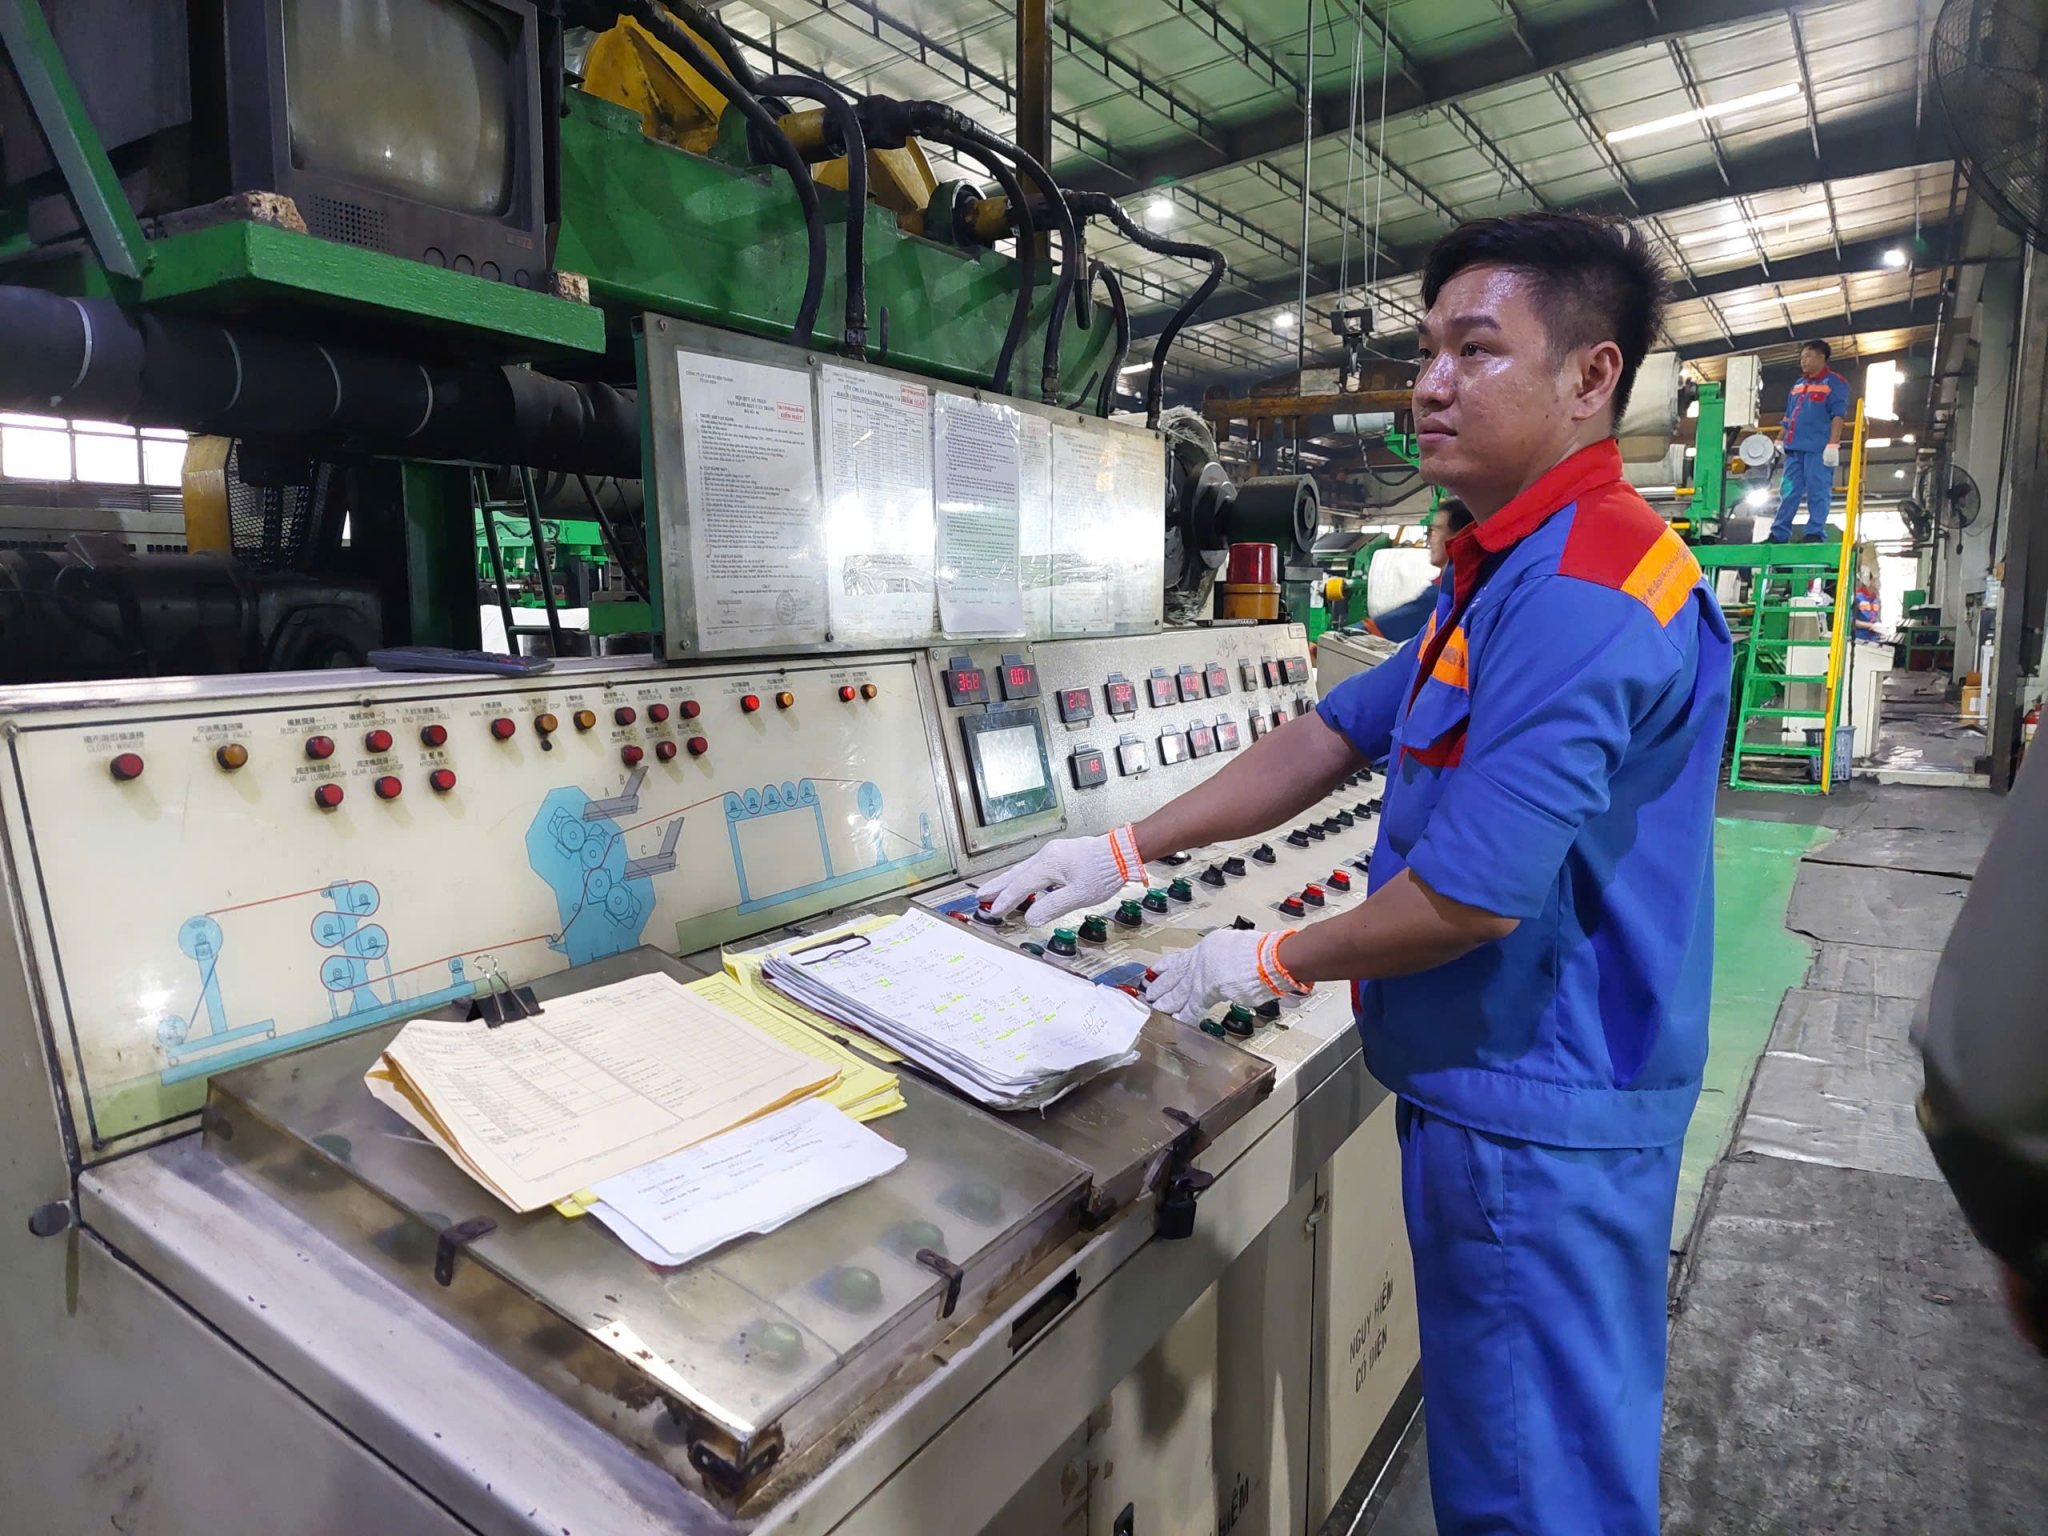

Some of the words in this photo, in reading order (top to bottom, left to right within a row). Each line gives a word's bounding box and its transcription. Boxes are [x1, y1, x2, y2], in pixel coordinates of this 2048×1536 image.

[958, 672, 980, 691] 368
[363, 718, 397, 727] LUBRICATOR
[301, 723, 338, 733] LUBRICATOR
[311, 771, 346, 781] LUBRICATOR
[619, 774, 625, 785] B
[604, 787, 610, 797] A
[656, 826, 662, 837] D
[641, 845, 647, 855] C
[1350, 1310, 1372, 1364] NGUY
